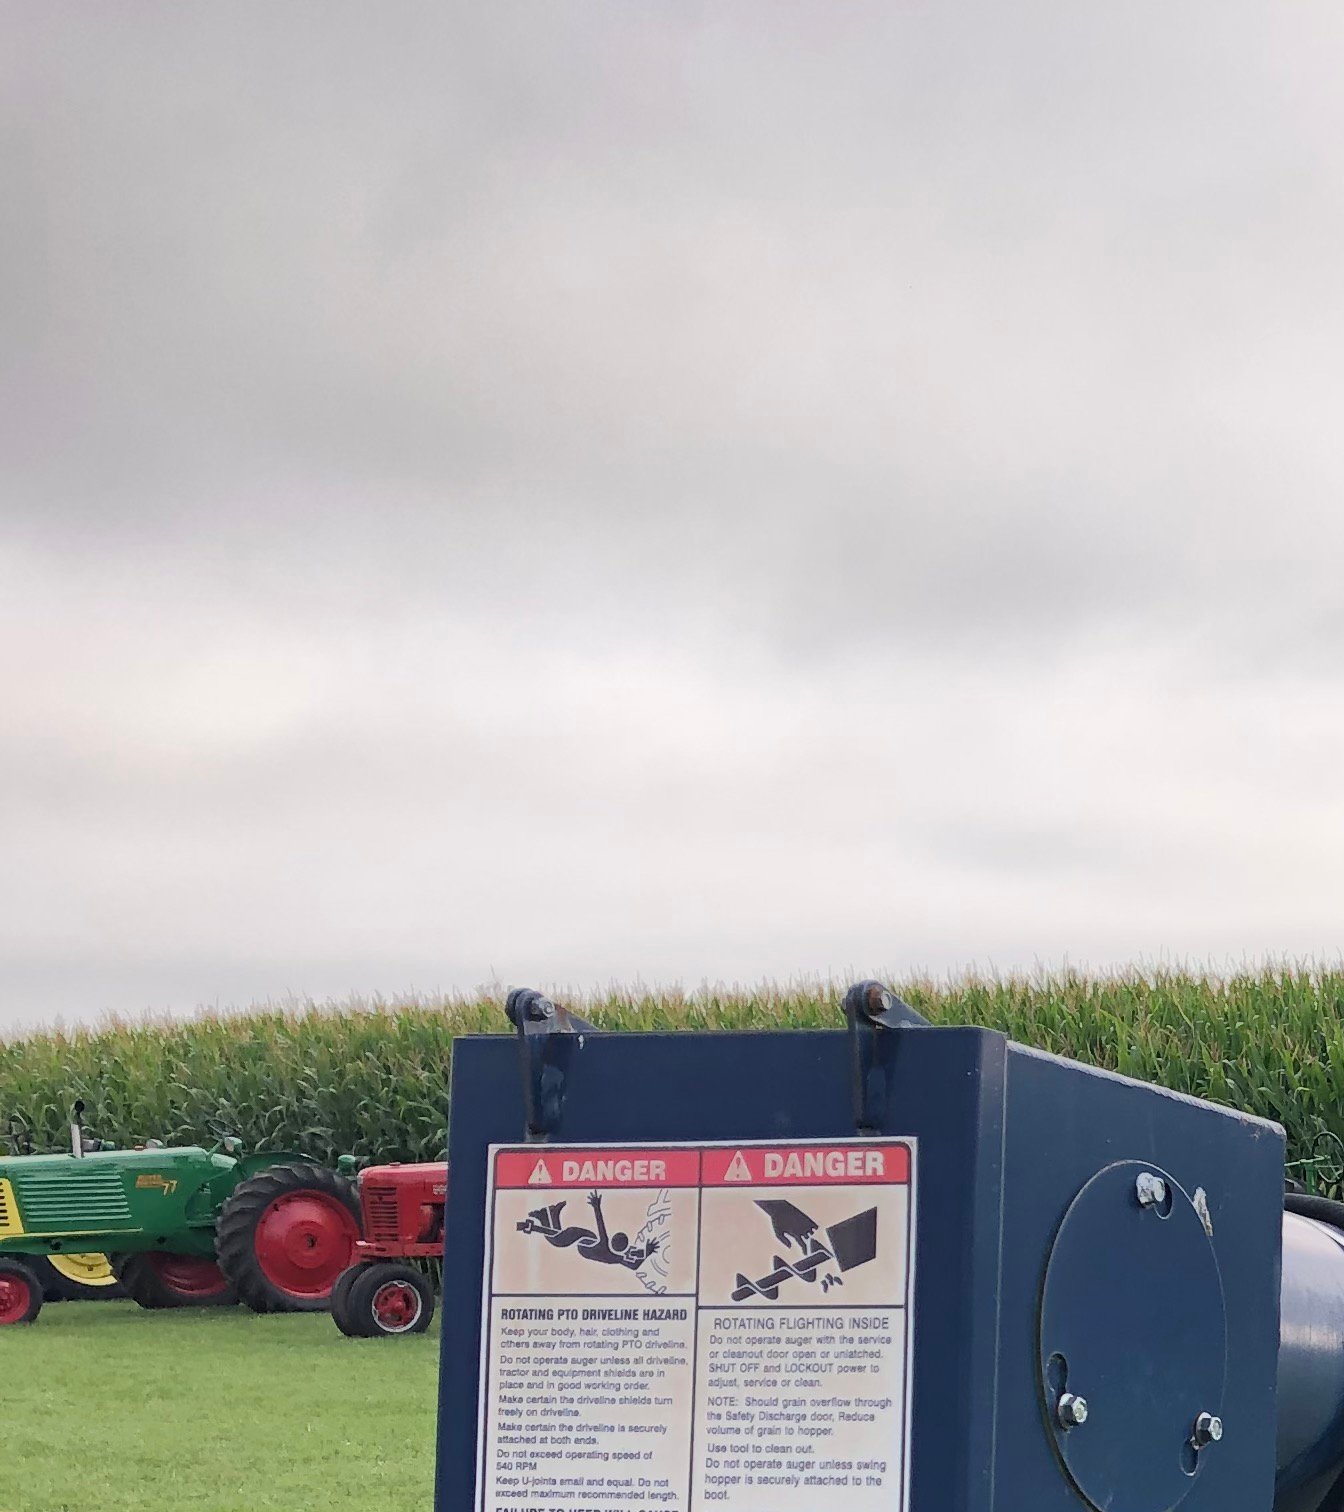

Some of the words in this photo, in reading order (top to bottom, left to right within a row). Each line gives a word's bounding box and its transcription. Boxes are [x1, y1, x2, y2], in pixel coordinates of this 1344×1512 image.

[763, 1151, 886, 1177] DANGER
[562, 1159, 667, 1182] DANGER
[162, 1180, 177, 1196] 77
[500, 1309, 554, 1320] ROTATING
[557, 1309, 578, 1320] PTO
[581, 1309, 639, 1320] DRIVELINE
[642, 1309, 687, 1320] HAZARD
[713, 1318, 774, 1329] ROTATING
[779, 1318, 844, 1329] FLIGHTING
[848, 1318, 889, 1329] INSIDE
[709, 1335, 724, 1344] Do
[726, 1335, 743, 1344] not
[744, 1336, 782, 1344] operate
[784, 1336, 813, 1345] auger
[815, 1335, 835, 1344] with
[838, 1335, 854, 1344] the
[857, 1336, 892, 1344] service
[708, 1350, 719, 1358] or
[722, 1350, 764, 1358] cleanout
[766, 1350, 789, 1358] door
[791, 1350, 816, 1359] open
[708, 1363, 736, 1372] SHUT
[739, 1363, 760, 1373] OFF
[763, 1363, 781, 1373] and
[784, 1363, 834, 1373] LOCKOUT
[836, 1365, 866, 1373] power
[870, 1364, 879, 1373] to
[743, 1379, 778, 1387] service
[780, 1379, 791, 1387] or
[707, 1397, 738, 1406] NOTE:
[744, 1397, 779, 1406] Should
[781, 1399, 807, 1408] grain
[809, 1397, 851, 1407] overflow
[854, 1398, 892, 1409] through
[706, 1412, 722, 1420] the
[725, 1412, 755, 1422] Safety
[758, 1412, 807, 1422] Discharge
[838, 1412, 875, 1421] Reduce
[705, 1426, 741, 1434] volume
[743, 1426, 754, 1435] of
[756, 1427, 781, 1436] grain
[784, 1426, 794, 1435] to
[707, 1443, 728, 1453] Use
[729, 1443, 749, 1453] tool
[751, 1444, 762, 1453] to
[764, 1444, 792, 1453] clean
[495, 1461, 513, 1470] 540
[515, 1462, 537, 1470] RPM
[705, 1457, 720, 1468] Do
[723, 1459, 740, 1468] not
[743, 1459, 783, 1470] operate
[785, 1460, 816, 1471] auger
[818, 1460, 853, 1470] unless
[856, 1461, 887, 1472] swing
[704, 1475, 741, 1486] hopper
[744, 1474, 753, 1484] is
[756, 1476, 800, 1486] securely
[803, 1475, 848, 1485] attached
[851, 1476, 862, 1486] to
[865, 1476, 882, 1486] the
